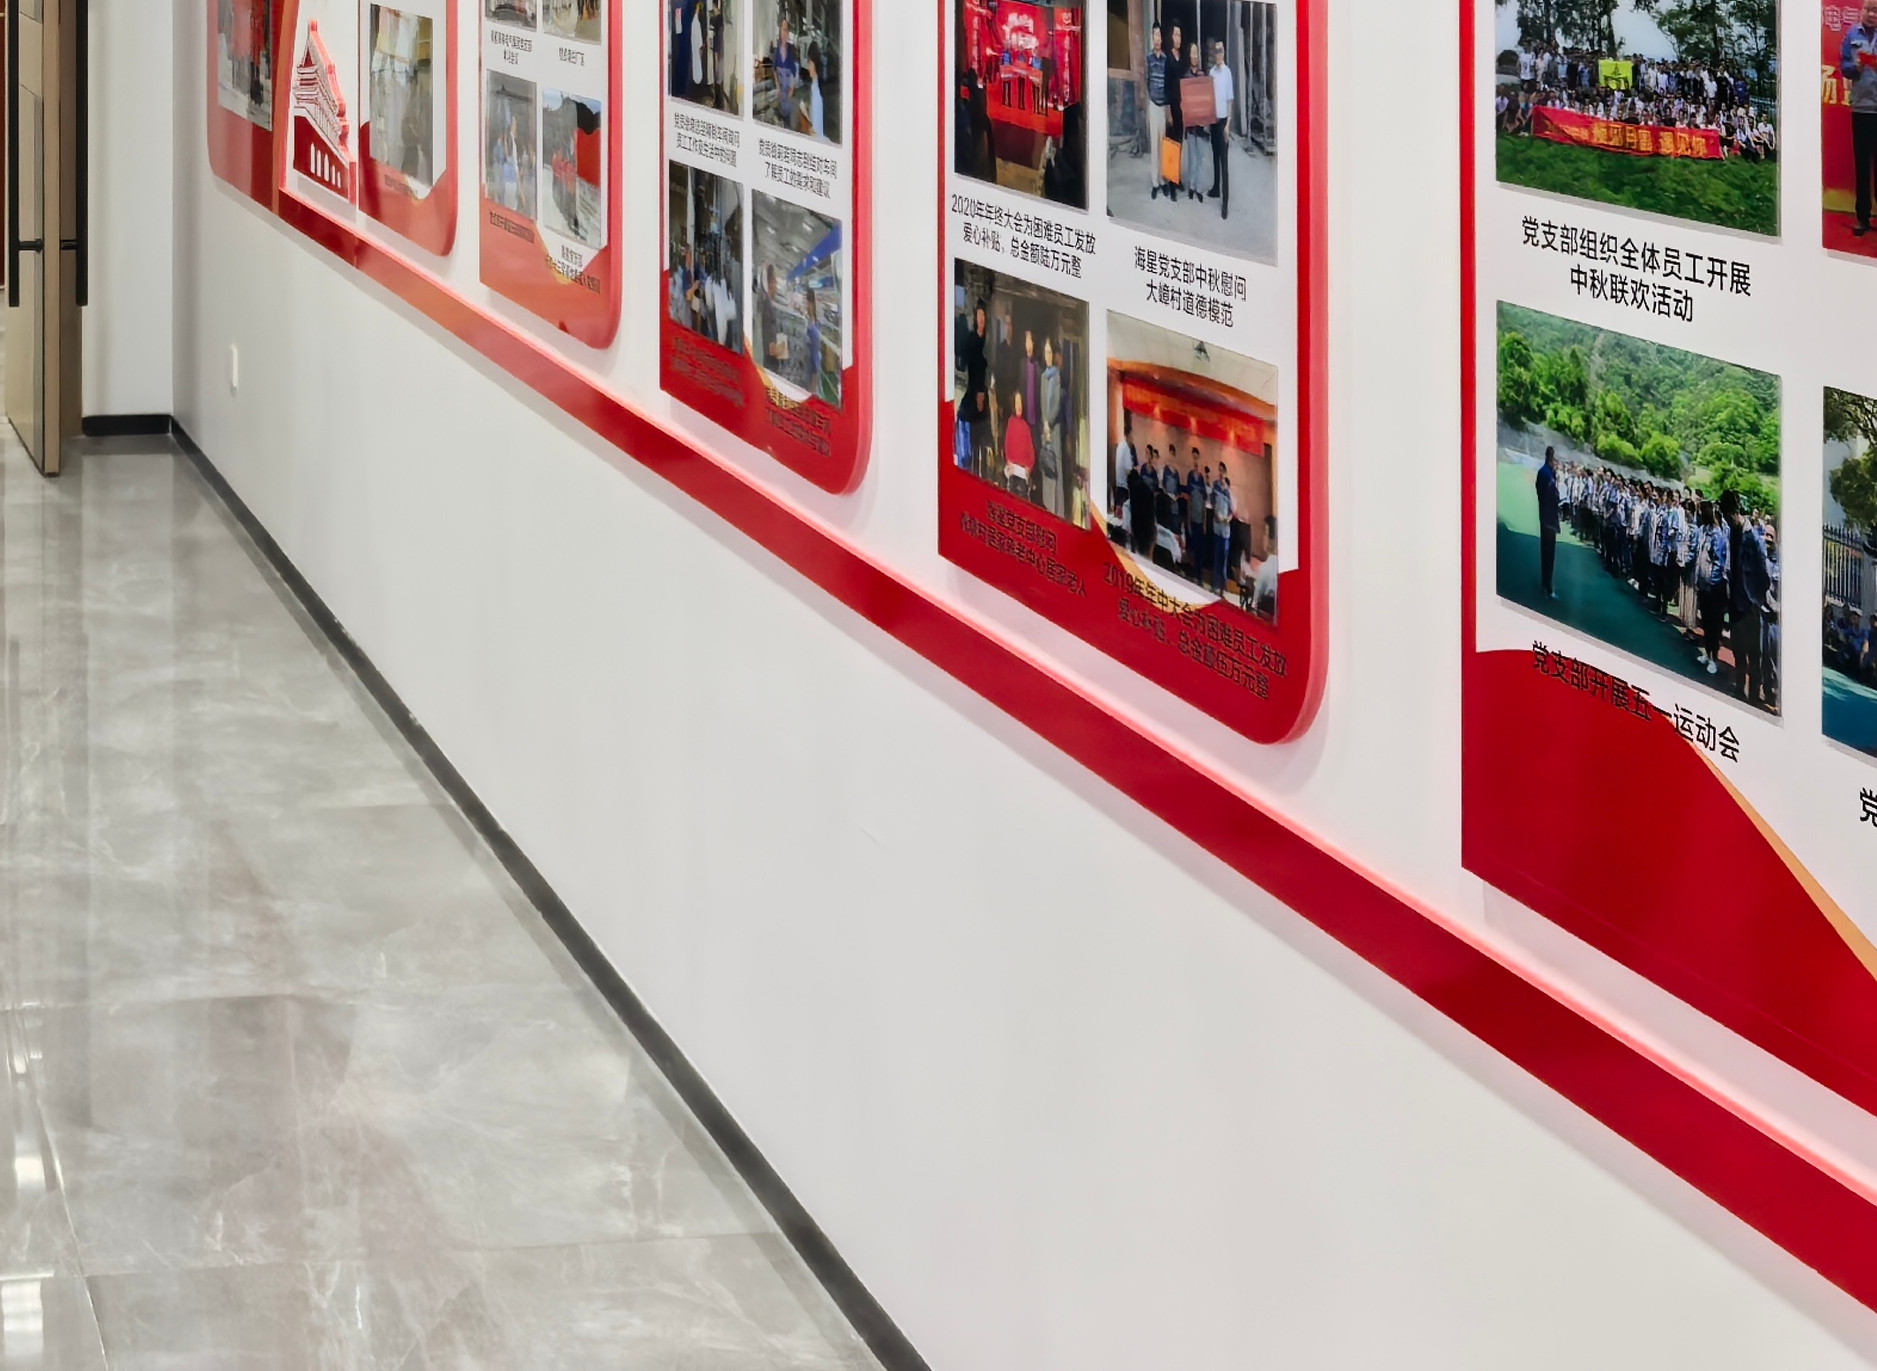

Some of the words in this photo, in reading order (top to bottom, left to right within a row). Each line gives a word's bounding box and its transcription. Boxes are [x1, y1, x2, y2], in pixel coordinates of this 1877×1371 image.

[1134, 246, 1247, 302] 海星党支部中秋慰问
[1522, 216, 1752, 297] 党支部组织全体员工开展
[1570, 262, 1694, 322] 中秋联欢活动
[1532, 641, 1740, 763] 党支部开展五一运动会
